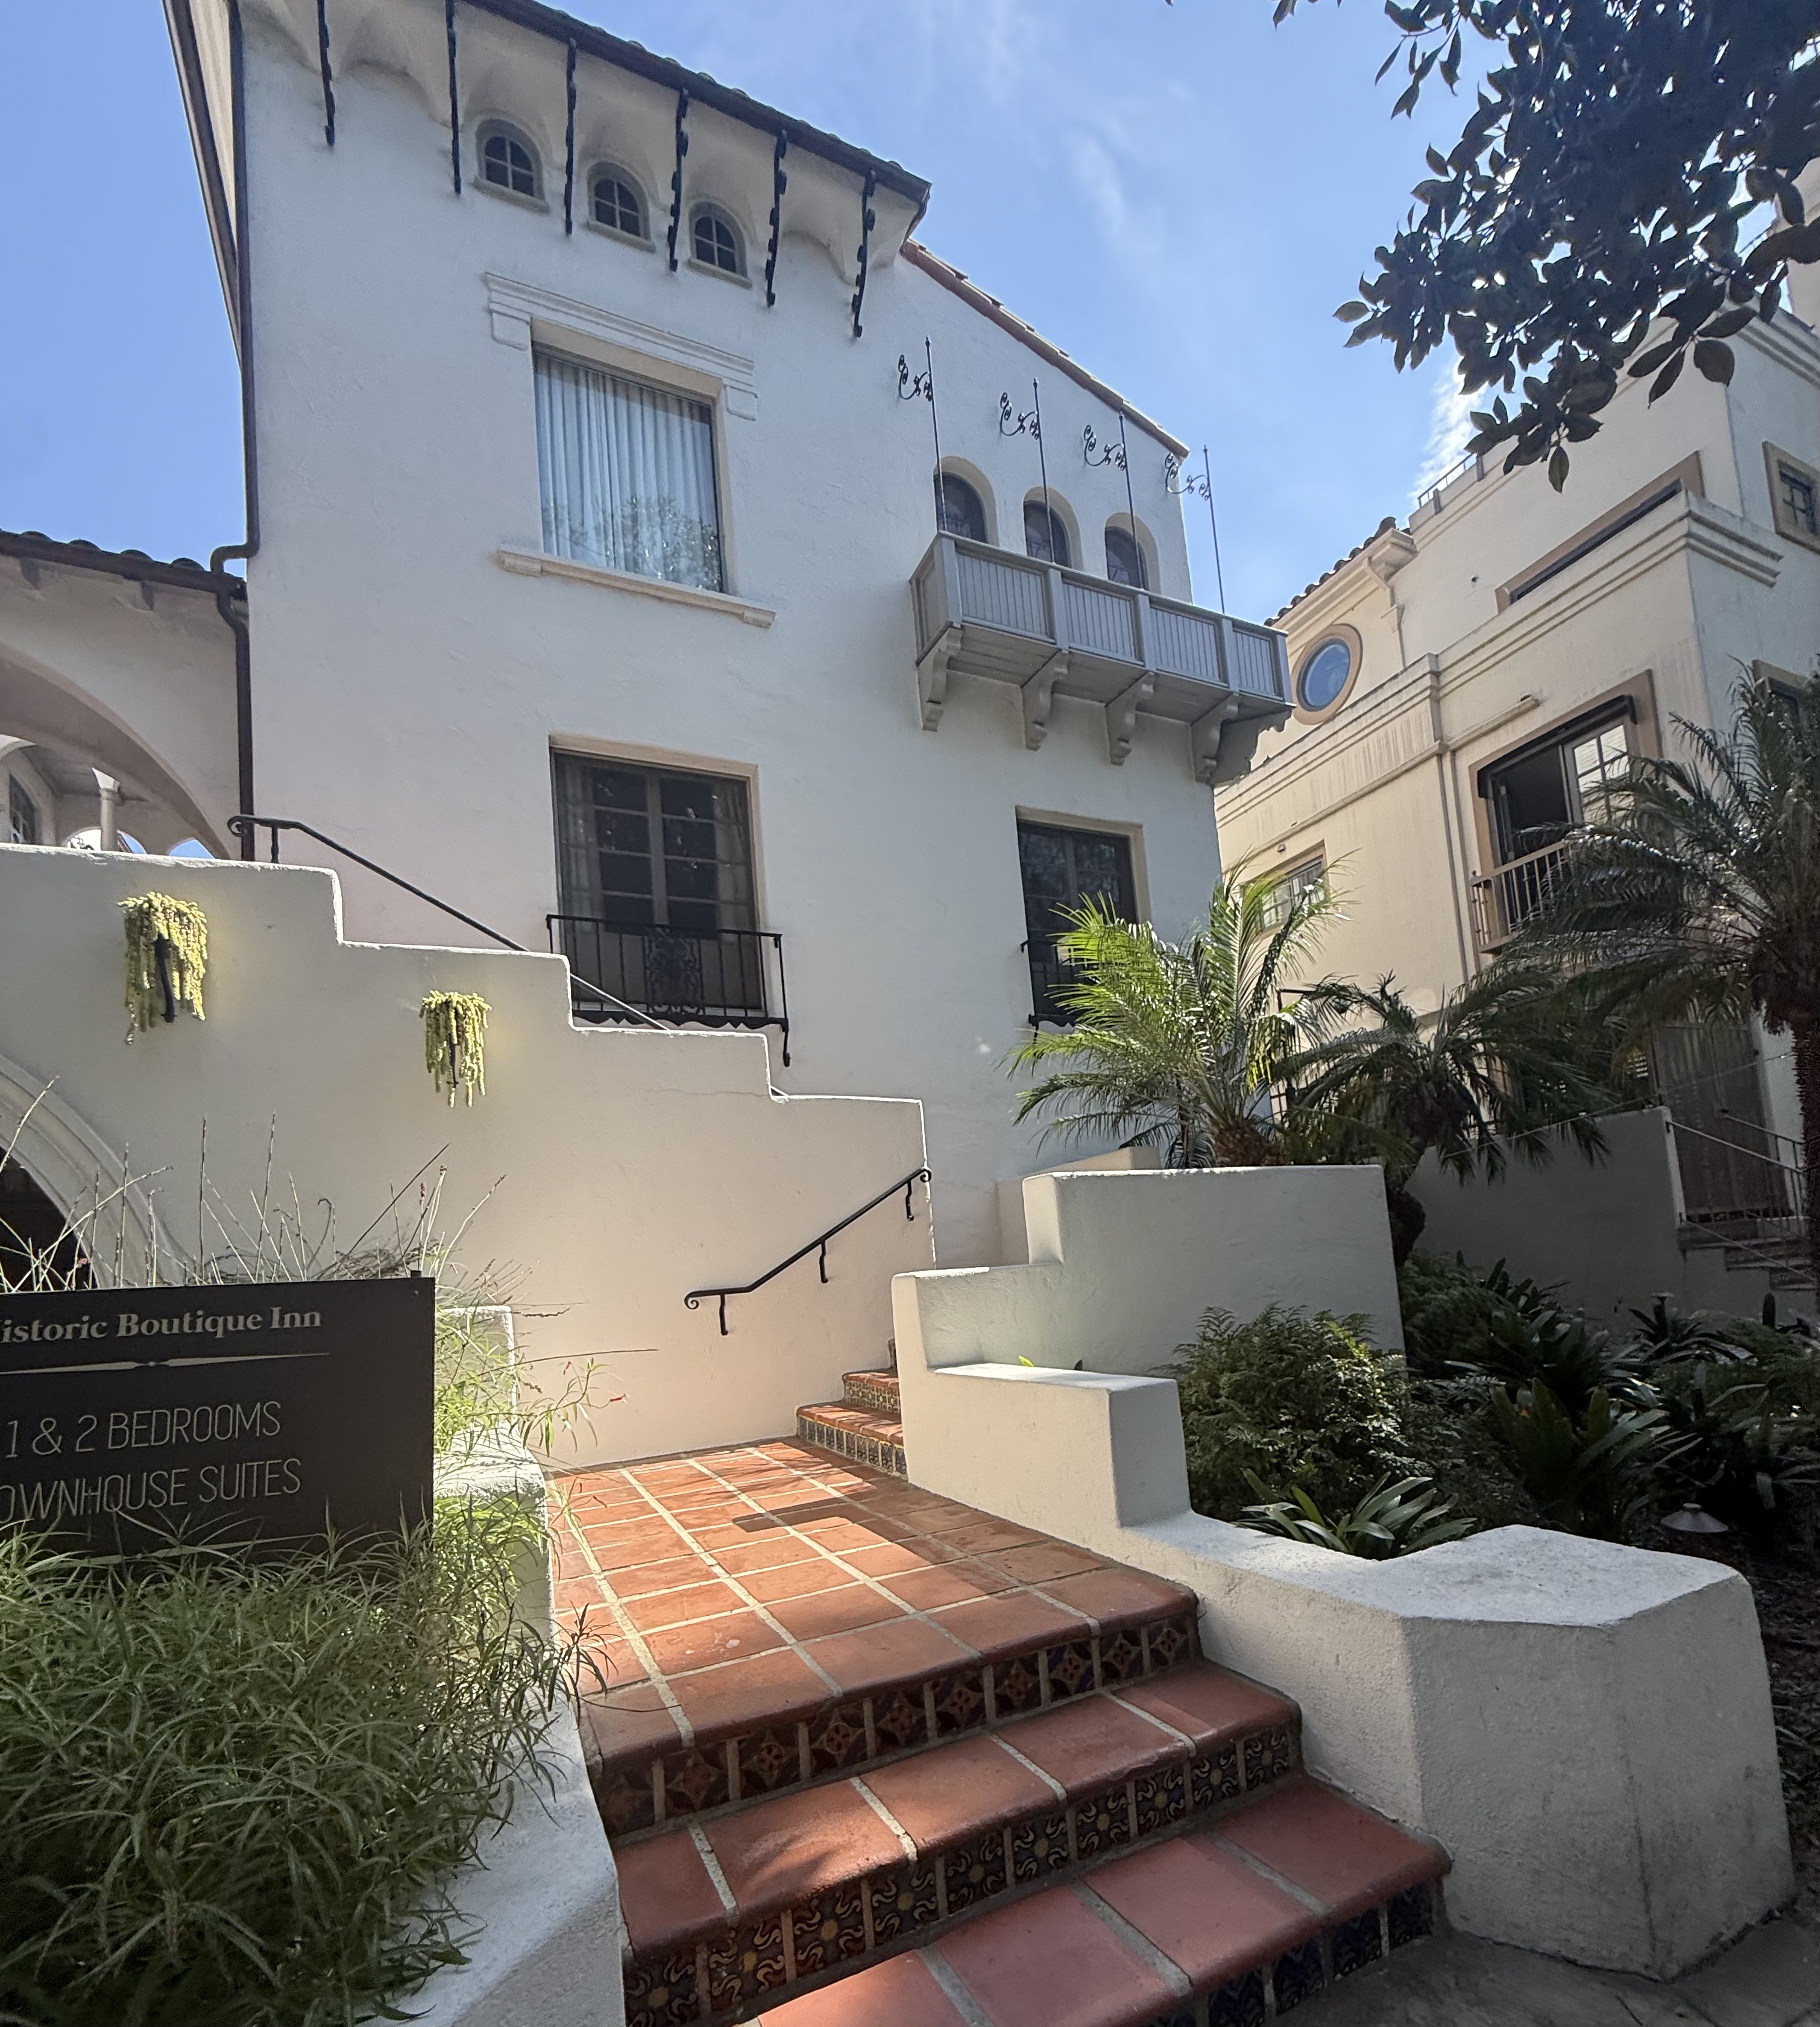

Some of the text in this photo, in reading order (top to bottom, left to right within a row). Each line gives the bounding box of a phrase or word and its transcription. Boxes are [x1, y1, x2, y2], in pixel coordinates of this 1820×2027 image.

[0, 1307, 321, 1343] istoric Boutique Inn
[7, 1401, 282, 1458] 1 & 2 BEDROOMS
[199, 1458, 301, 1502] SUITES
